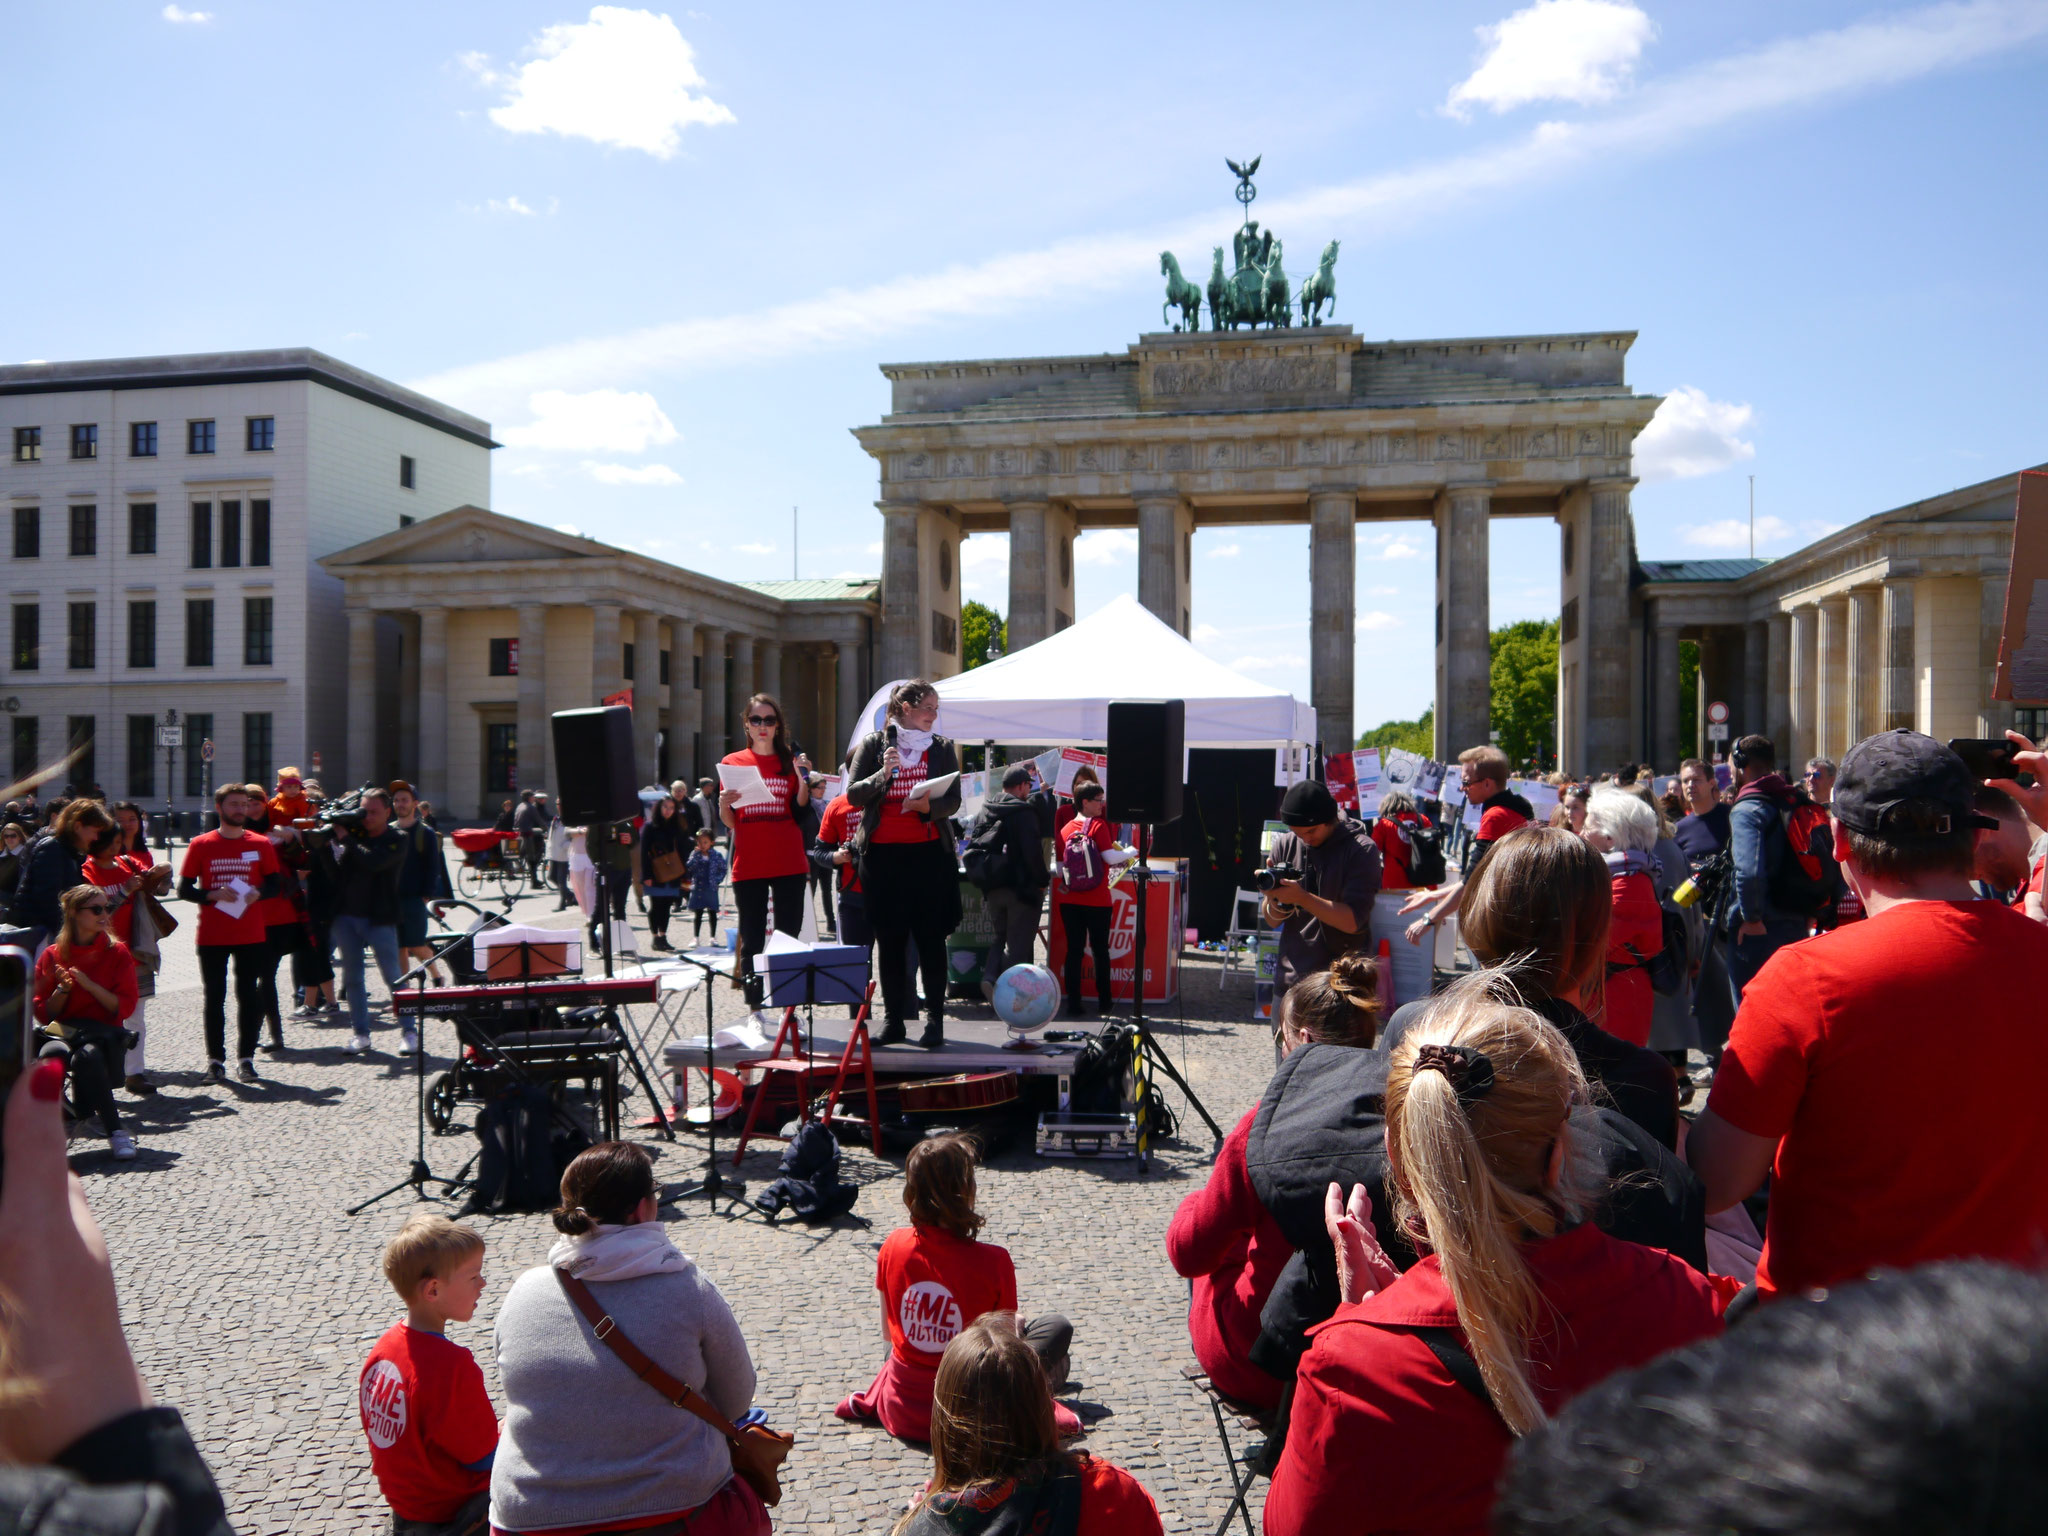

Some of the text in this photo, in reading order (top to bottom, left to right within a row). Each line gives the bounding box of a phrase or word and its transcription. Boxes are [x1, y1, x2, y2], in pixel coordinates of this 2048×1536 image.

[1110, 968, 1152, 982] MISSG
[903, 1290, 956, 1329] #ME
[905, 1322, 959, 1344] ACTION
[364, 1368, 406, 1420] #ME
